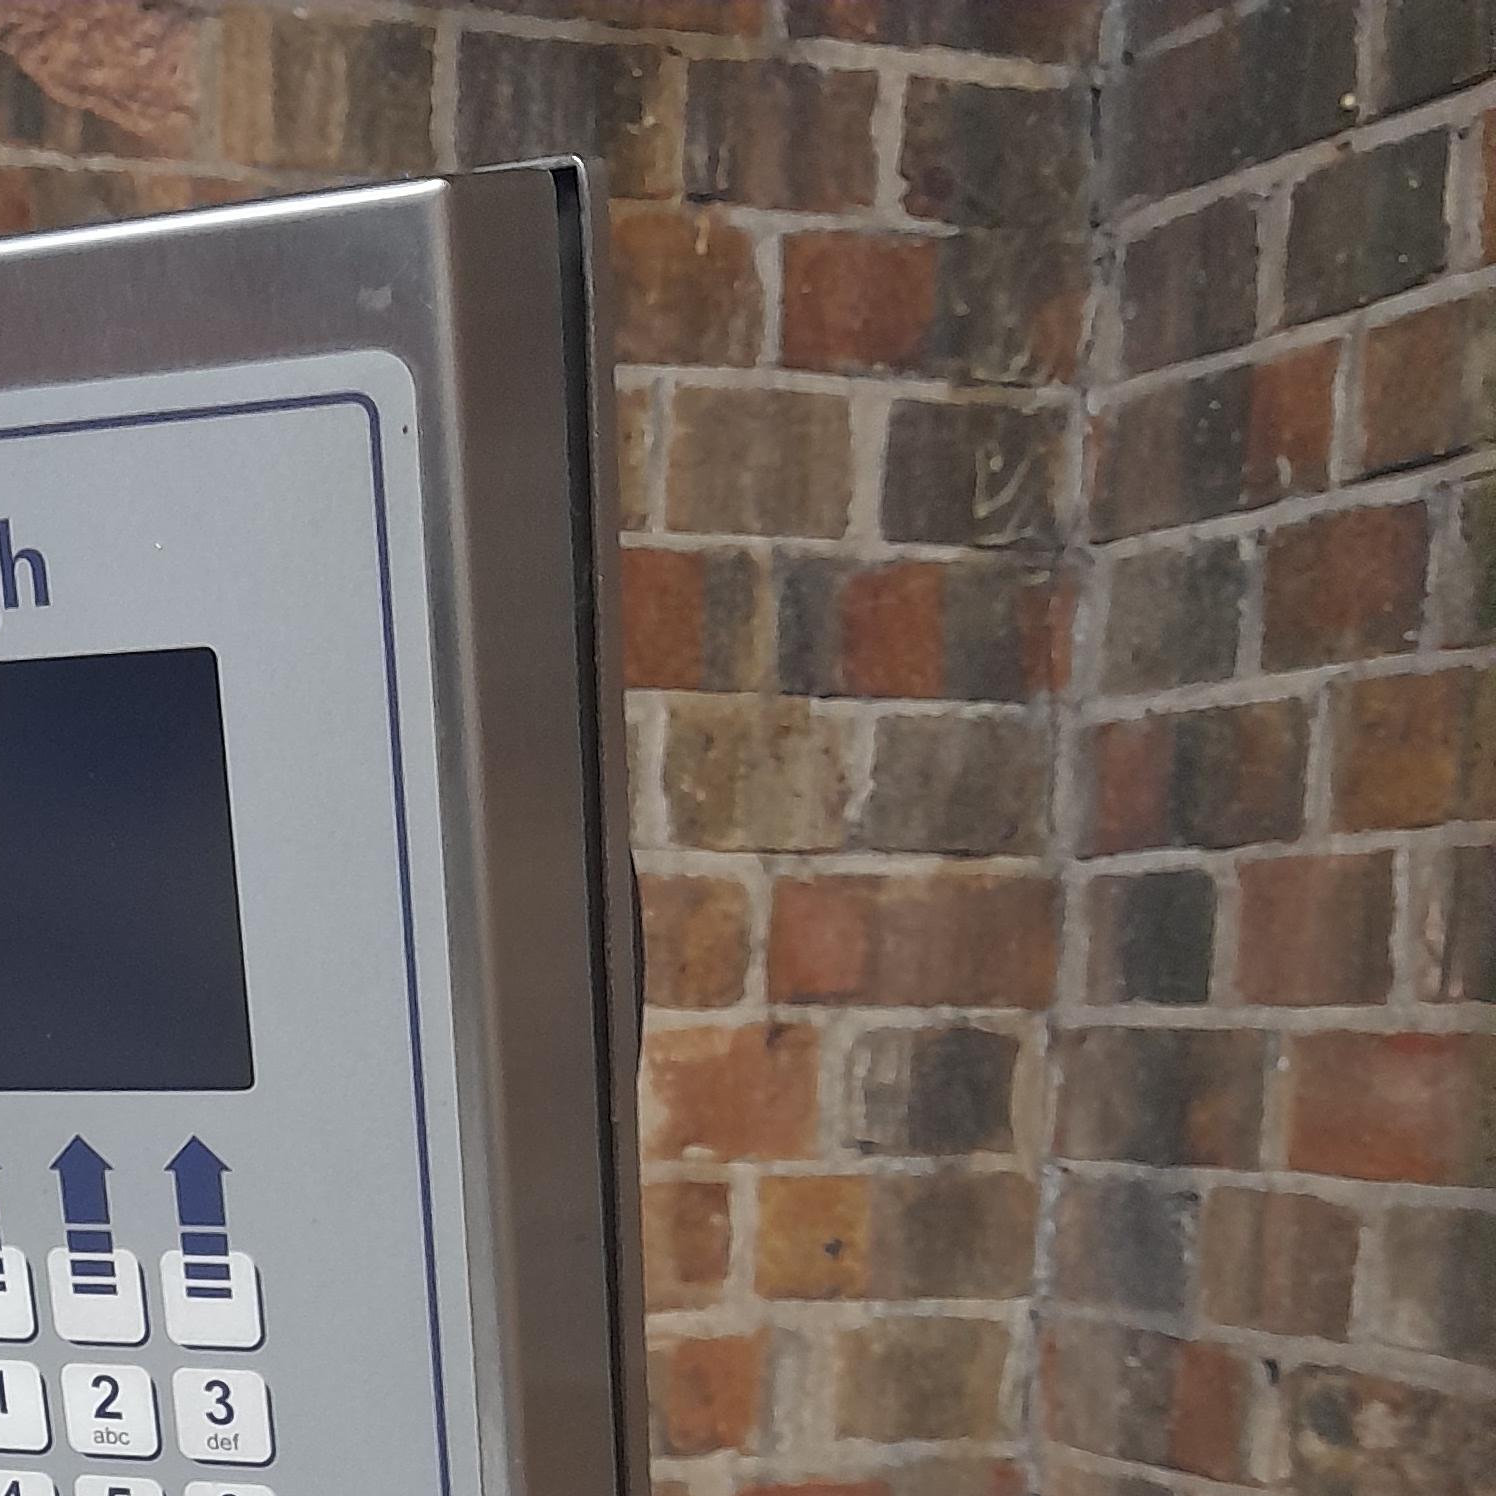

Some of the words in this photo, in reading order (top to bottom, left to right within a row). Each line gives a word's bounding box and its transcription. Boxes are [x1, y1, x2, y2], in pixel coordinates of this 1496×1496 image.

[91, 1375, 123, 1420] 2
[204, 1380, 234, 1425] 3
[94, 1427, 130, 1445] abc
[207, 1433, 239, 1451] def
